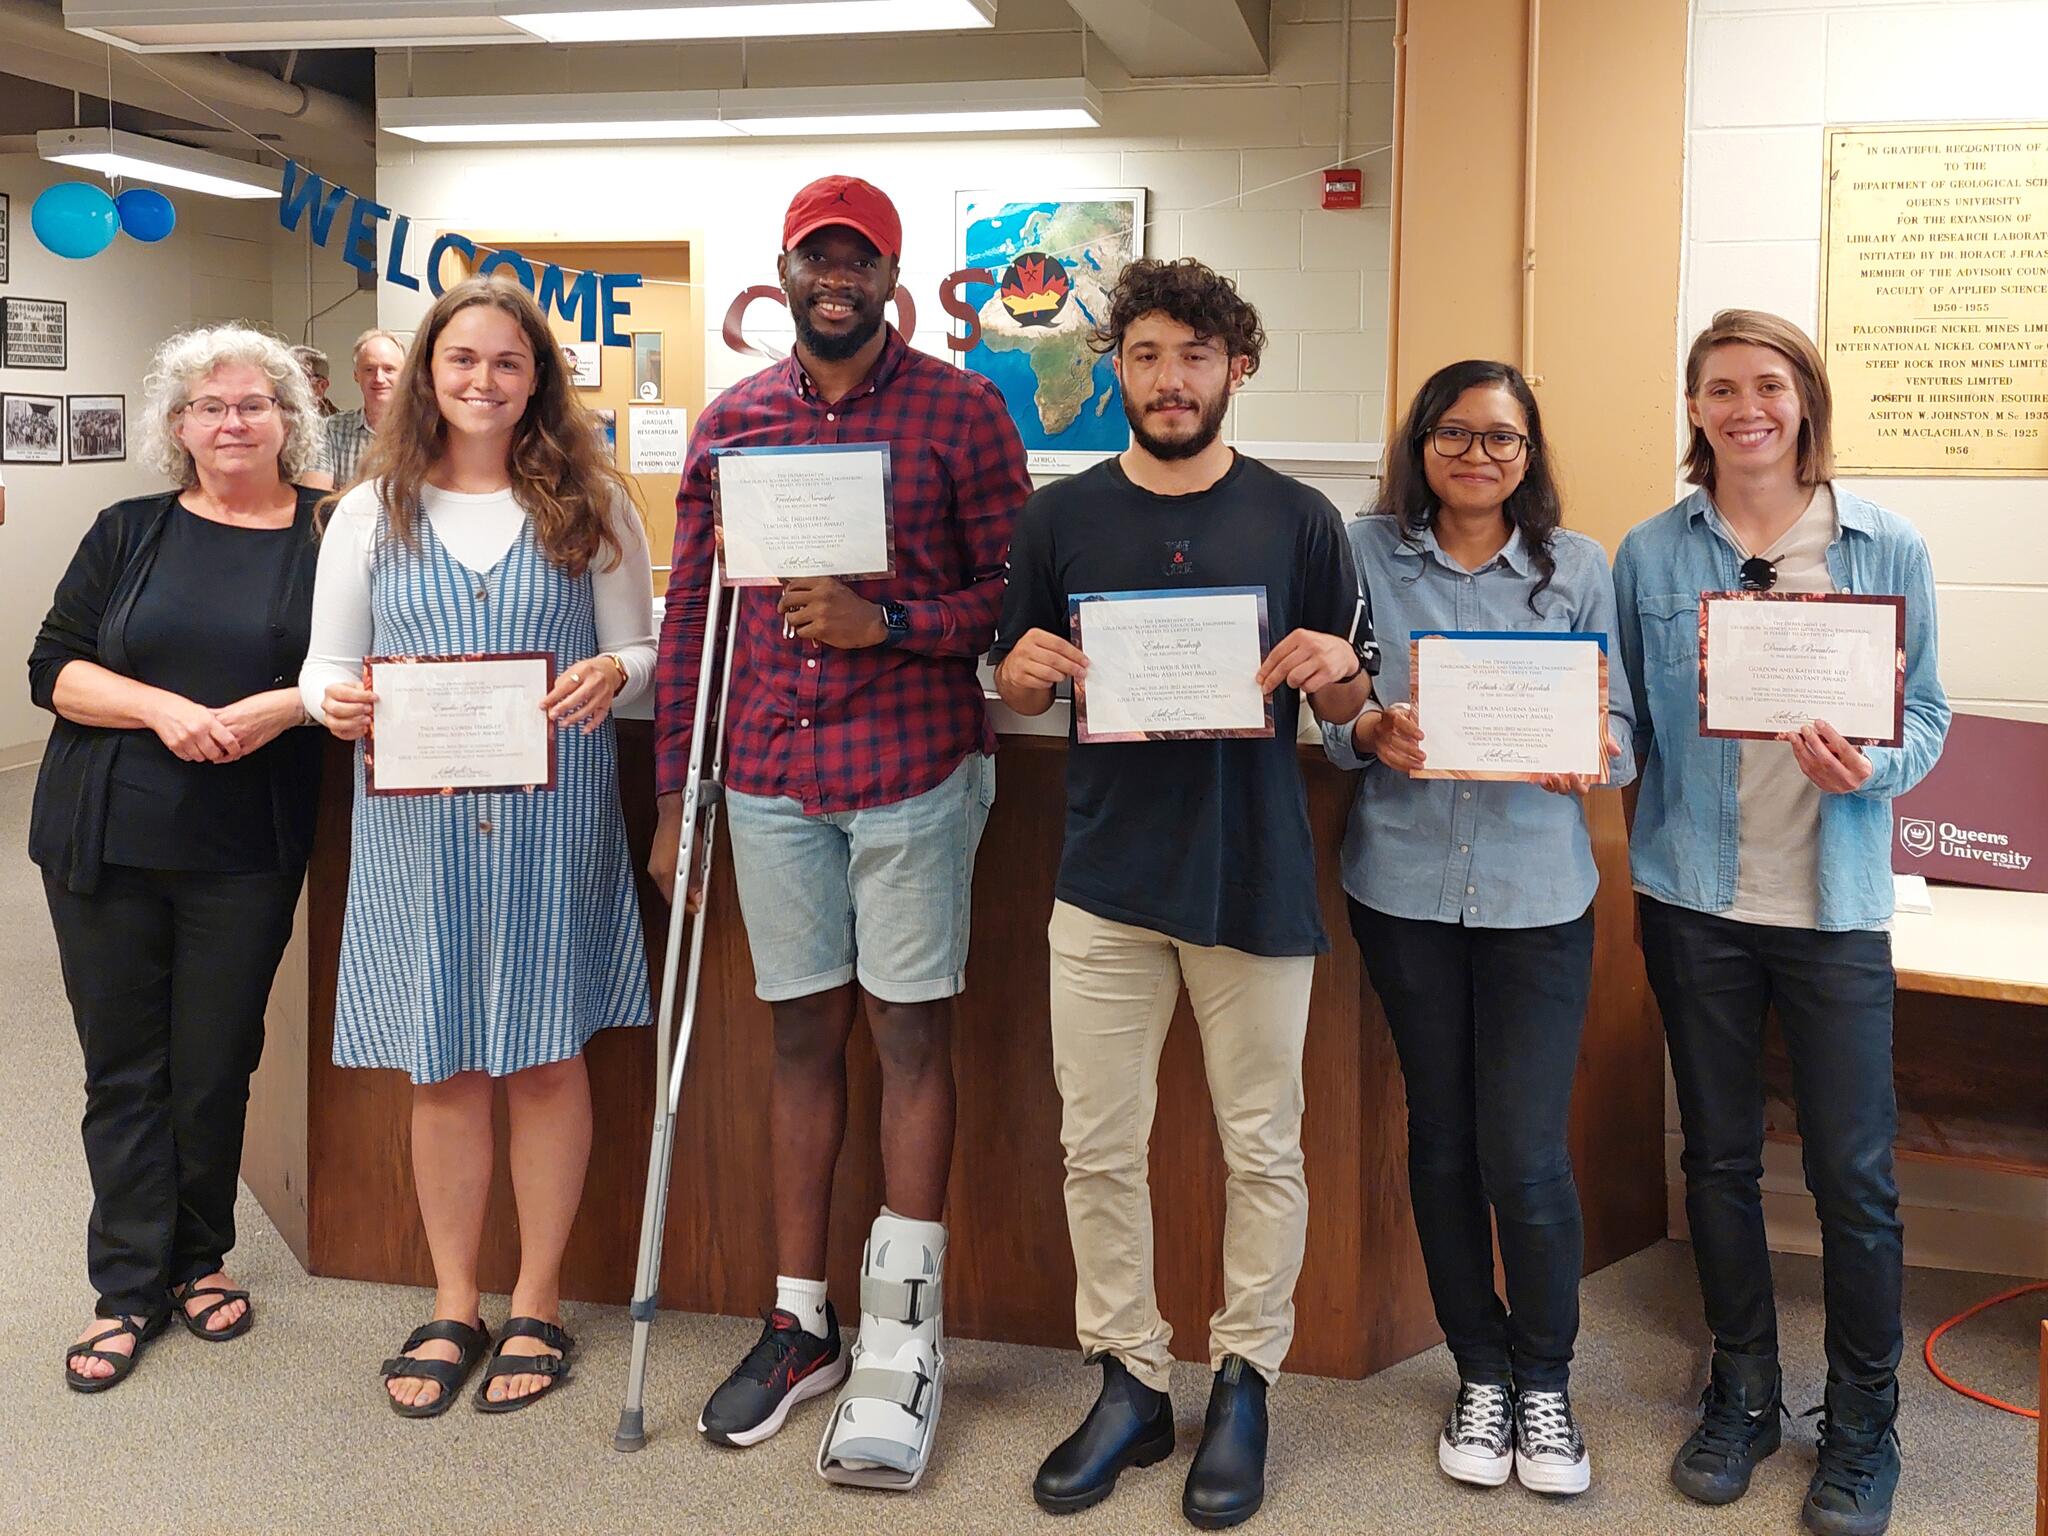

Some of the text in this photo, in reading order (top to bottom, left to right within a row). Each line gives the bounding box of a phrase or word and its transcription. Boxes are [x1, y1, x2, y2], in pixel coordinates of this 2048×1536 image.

[1867, 146, 1878, 155] IN
[1883, 145, 1941, 155] GRATEFUL
[1946, 143, 2021, 153] RECOGNITION
[2026, 143, 2042, 152] OF
[1945, 162, 1986, 171] TO THE
[1853, 180, 1927, 191] DEPARTMENT
[1931, 180, 1945, 189] OF
[1950, 179, 2021, 189] GEOLOGICAL
[1955, 197, 2021, 206] UNIVERSITY
[1897, 214, 2032, 225] FOR THE EXPANSION OF
[1847, 231, 2048, 243] LIBRARY AND RESEARCH LABORAT
[279, 160, 643, 348] WELCOME
[1859, 251, 1916, 261] INITIATED
[1920, 251, 1935, 260] BY
[1960, 250, 2006, 259] HORACE
[1860, 267, 2048, 278] MEMBER OF THE ADVISORY COUN
[1876, 285, 2048, 296] FACULTY OF APPLIED SCIENCE
[1853, 325, 1937, 334] FALCONBRIDGE
[1941, 325, 1981, 334] NICKEL
[1985, 324, 2020, 333] MINES
[1835, 342, 1930, 352] INTERNATIONAL
[1935, 342, 1975, 351] NICKEL
[1978, 341, 2031, 351] COMPANY
[1865, 360, 1899, 369] STEEP
[1904, 360, 1934, 369] ROCK
[1939, 359, 1967, 368] IRON
[1971, 359, 2005, 368] MINES
[1906, 376, 2013, 386] VENTURES LIMITED
[1870, 394, 1911, 403] JOSEPH
[2001, 394, 2048, 403] ESQUIRE
[1868, 411, 1913, 420] ASHTON
[1878, 429, 1897, 438] IAN
[2014, 428, 2039, 437] 1925
[1945, 446, 1969, 455] 1956
[1939, 840, 2033, 871] University
